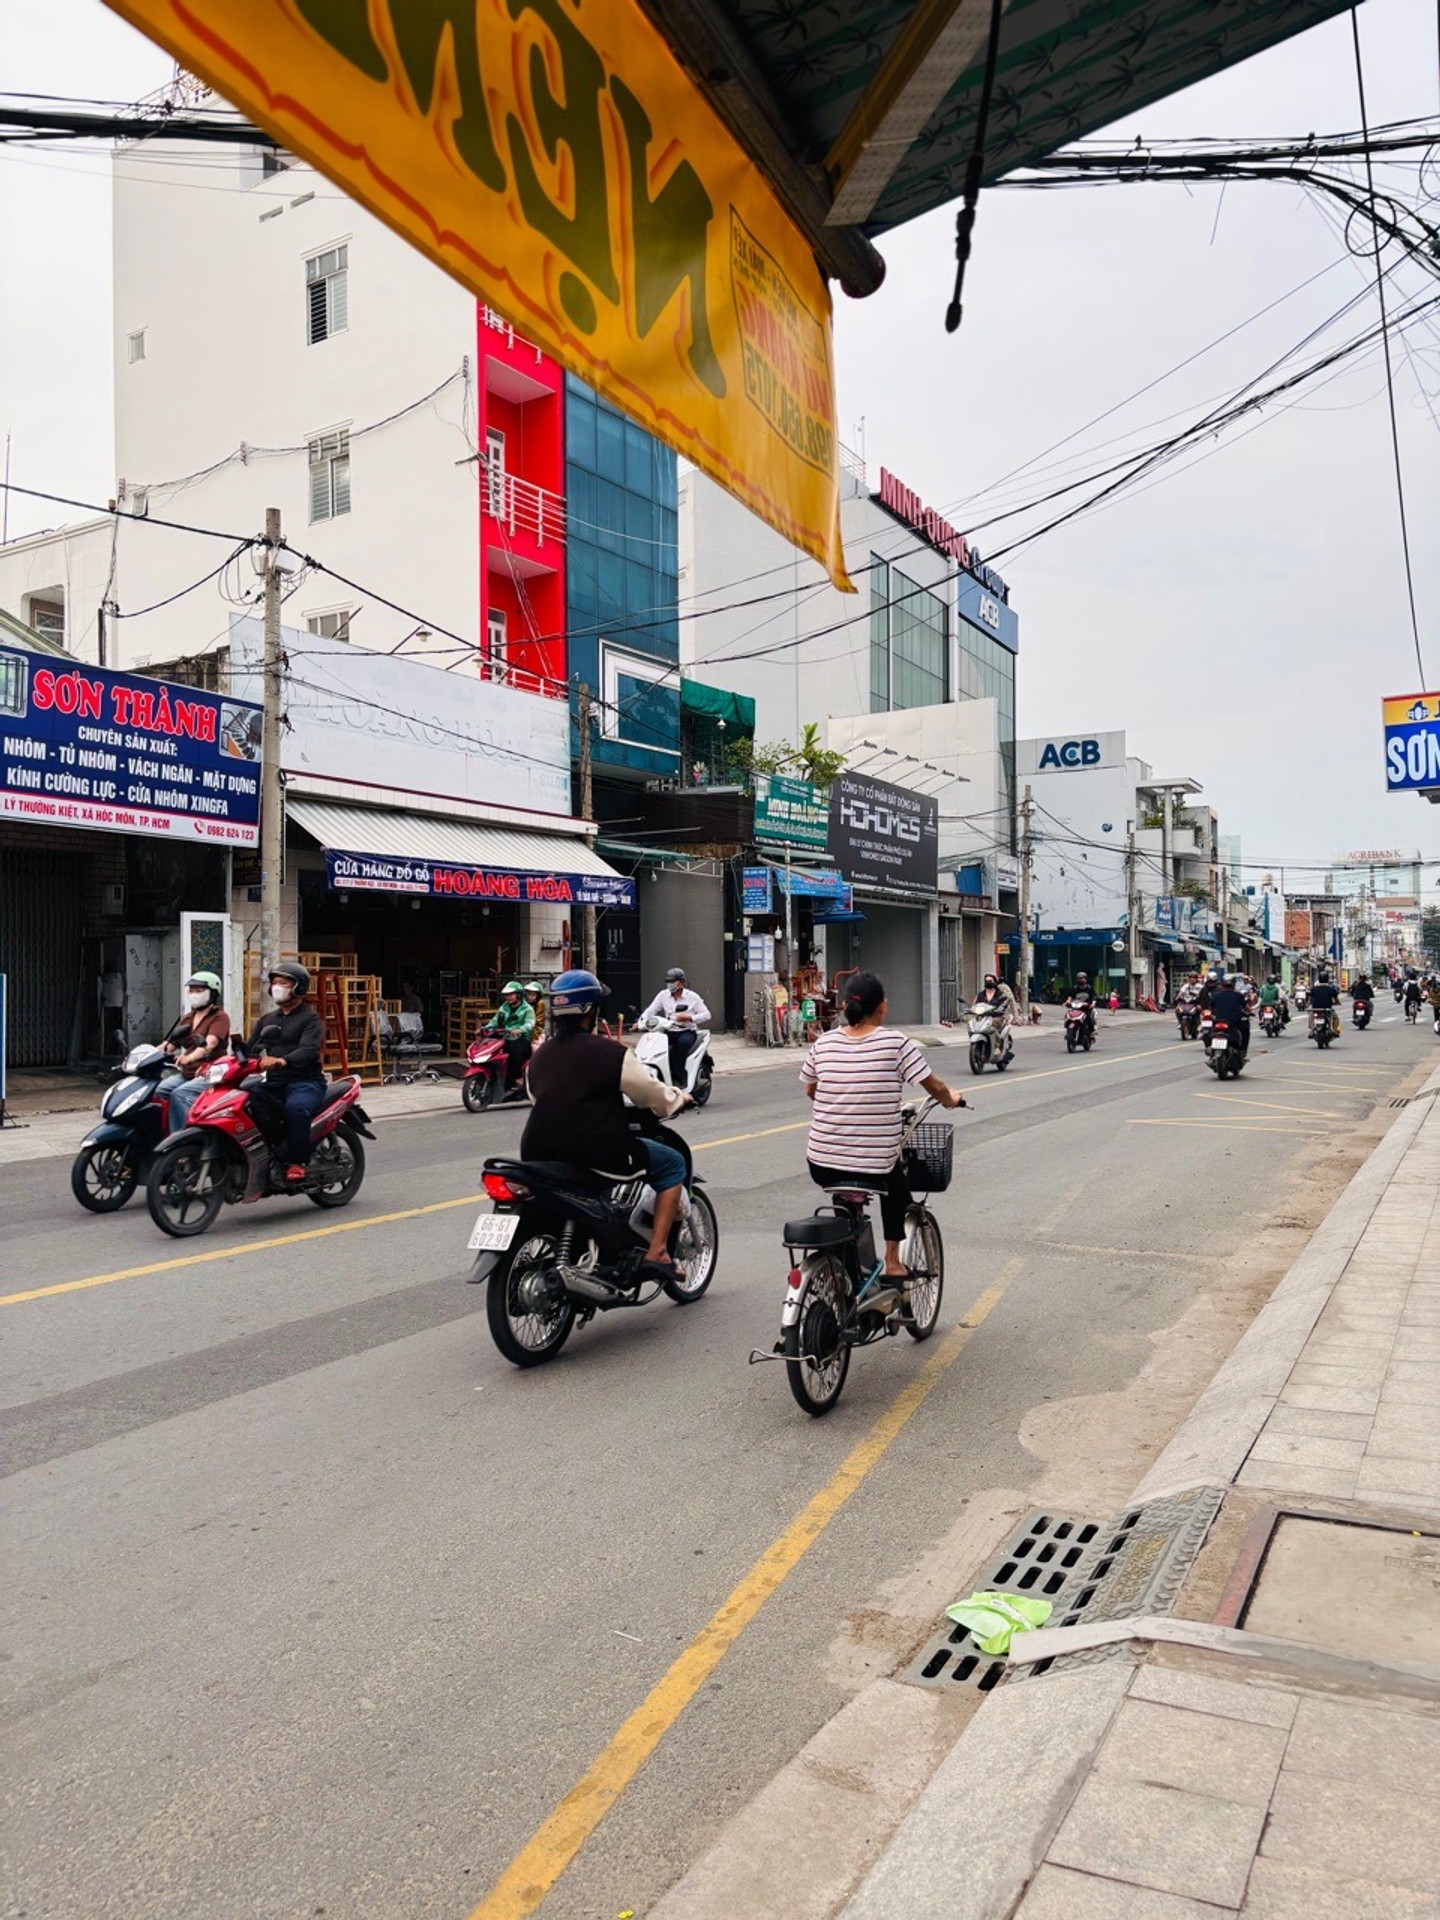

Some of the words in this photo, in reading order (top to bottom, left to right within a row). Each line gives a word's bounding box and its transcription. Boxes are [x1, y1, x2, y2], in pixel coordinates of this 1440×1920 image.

[880, 466, 923, 531] MINH
[978, 594, 999, 629] ACB
[32, 669, 104, 720] SƠN
[110, 686, 217, 743] THÀNH
[78, 725, 122, 746] CHUYÊN
[124, 731, 148, 751] SẢN
[149, 736, 178, 757] XUẤT:
[1038, 739, 1101, 769] ACB
[3, 737, 46, 760] NHÔM
[59, 742, 76, 765] TỦ
[79, 749, 117, 772] NHÔM
[128, 756, 158, 779] VÁCH
[161, 763, 194, 784] NGĂN
[202, 770, 228, 792] MẶT
[228, 776, 257, 796] DỰNG
[7, 765, 41, 789] KÍNH
[45, 771, 90, 796] CƯỜNG
[93, 780, 117, 802] LỰC
[128, 781, 151, 805] CỬA
[154, 788, 188, 811] NHÔM
[190, 795, 228, 816] XINGFA
[4, 797, 16, 811] LÝ
[18, 799, 56, 816] THƯỜNG
[152, 818, 170, 829] HCM
[1347, 849, 1401, 859] AGRIBANK
[334, 858, 358, 875] CỬA
[362, 860, 393, 878] HÀNG
[396, 861, 412, 880] ĐỒ
[433, 867, 519, 898] HOÀNG
[527, 873, 573, 901] HÓA
